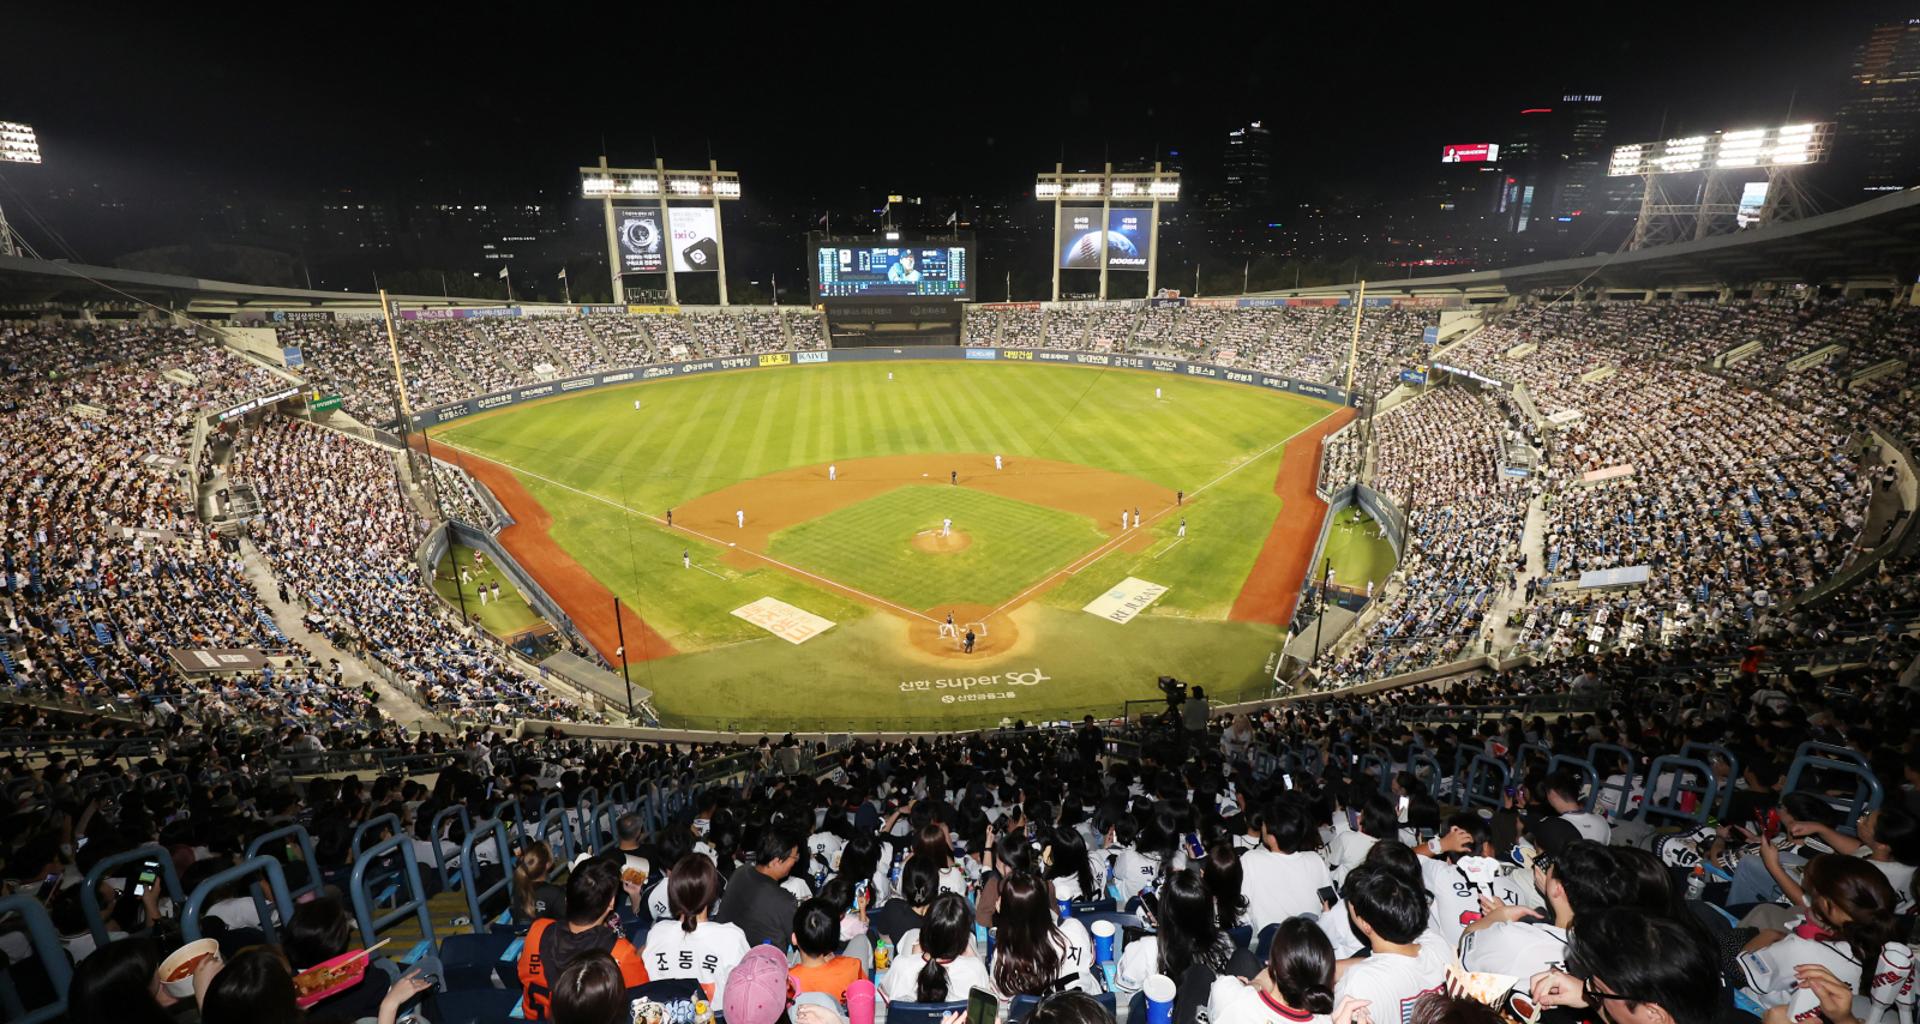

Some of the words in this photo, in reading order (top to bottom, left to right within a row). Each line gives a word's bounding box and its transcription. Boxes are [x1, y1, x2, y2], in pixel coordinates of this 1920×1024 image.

[721, 358, 751, 369] 현대해상
[1152, 360, 1177, 368] ALPACA
[898, 680, 931, 691] 신한
[935, 675, 1001, 690] super
[1004, 668, 1052, 686] SOL
[957, 691, 1017, 702] 신한금융그룹
[656, 950, 719, 974] 조동욱
